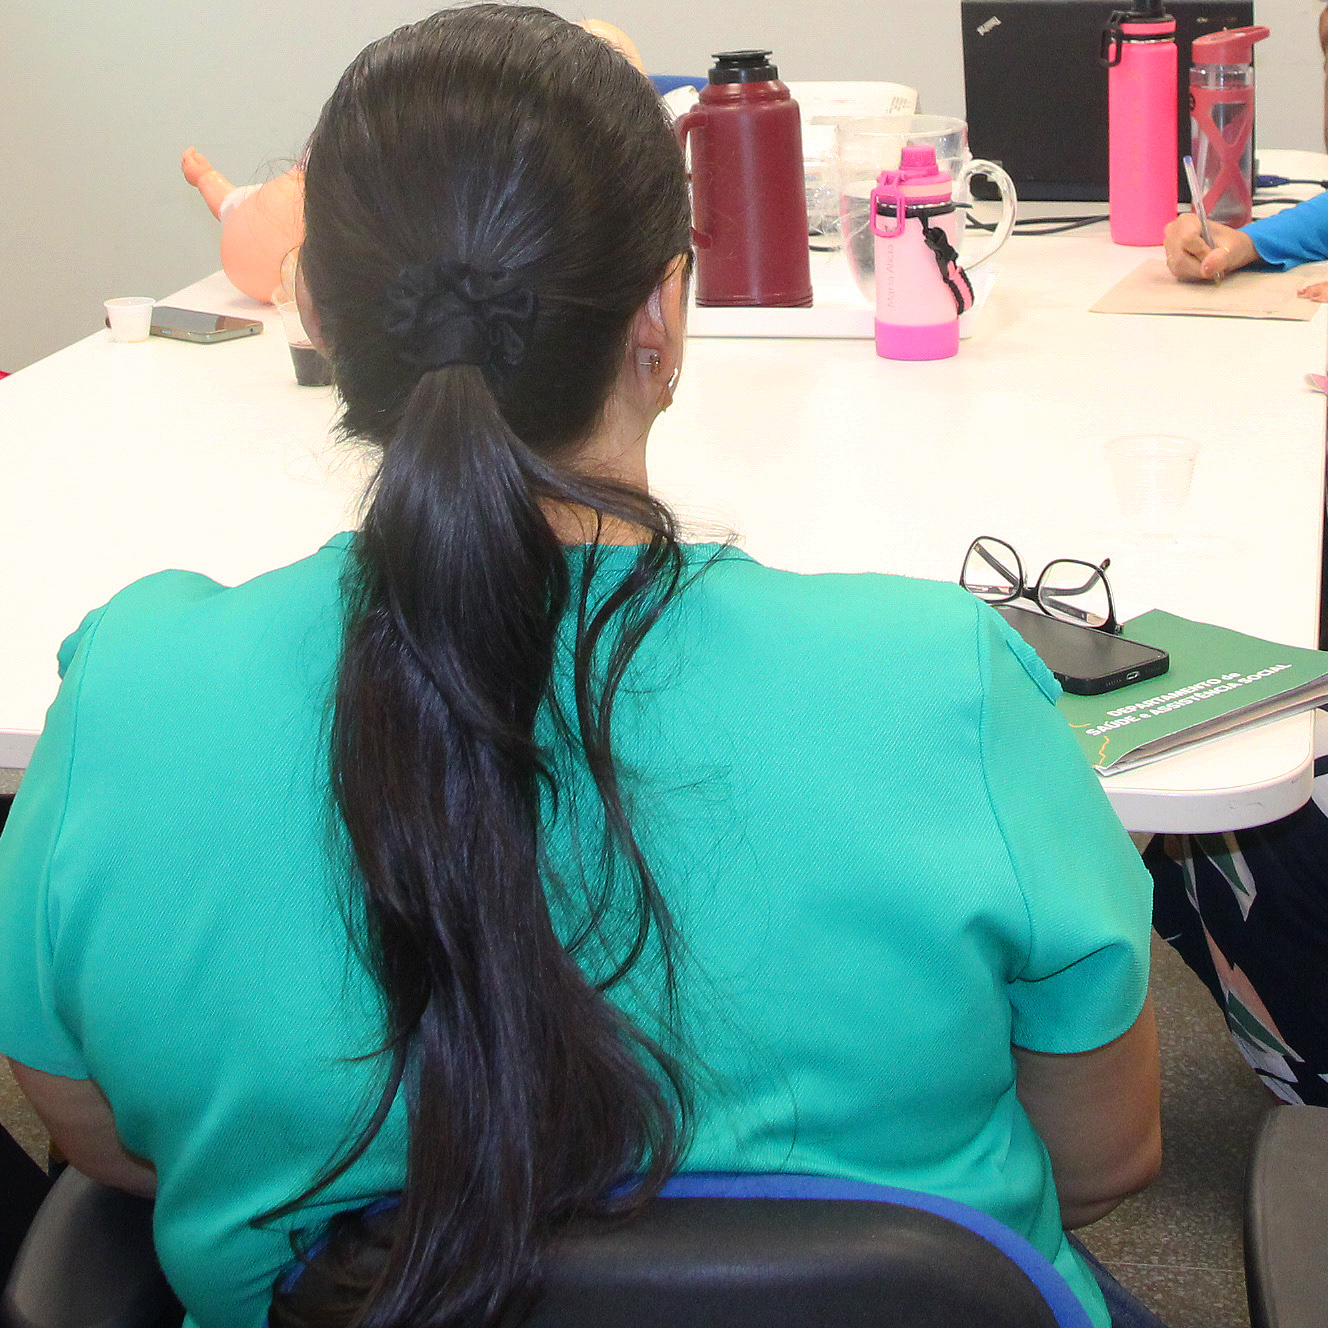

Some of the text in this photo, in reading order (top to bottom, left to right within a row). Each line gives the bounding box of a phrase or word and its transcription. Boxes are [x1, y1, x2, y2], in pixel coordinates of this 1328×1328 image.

[1085, 714, 1141, 737] SAÚDE
[1149, 681, 1242, 716] ASSISTÊNCIA
[1237, 663, 1293, 685] SOCIAL
[1106, 672, 1242, 717] DEPARTAMENTO de
